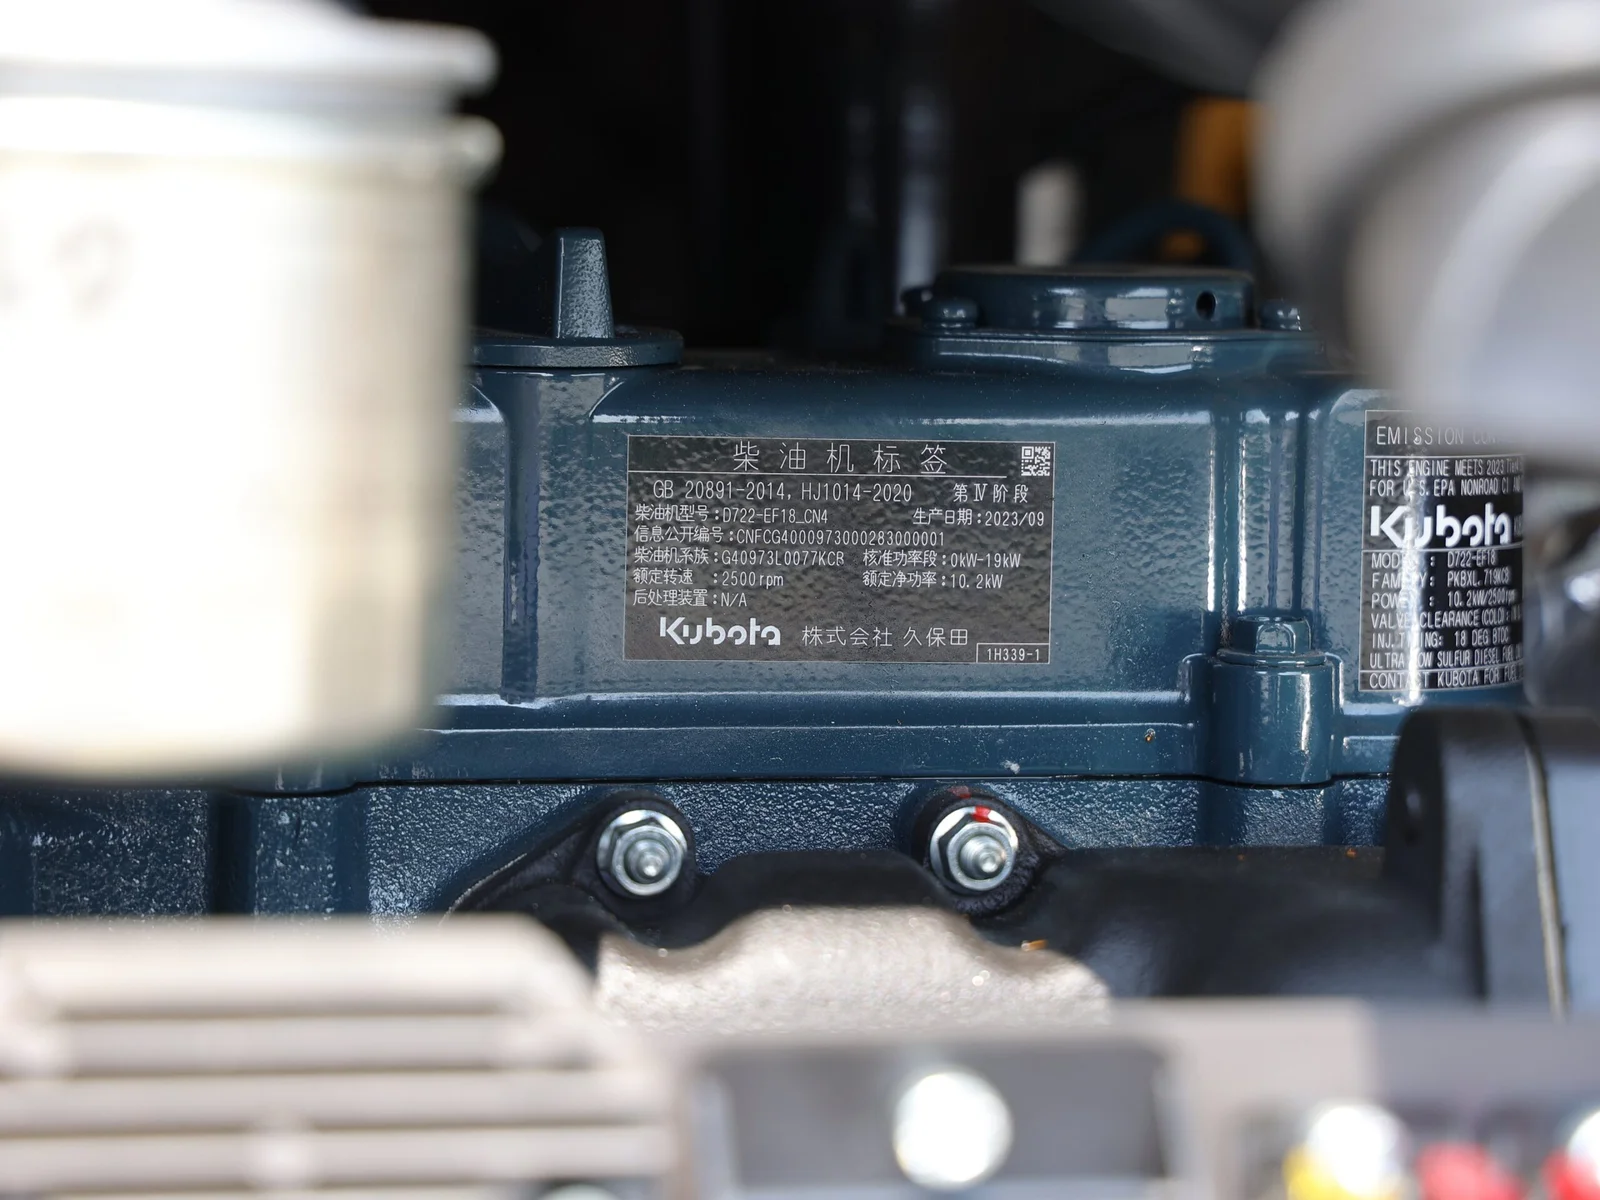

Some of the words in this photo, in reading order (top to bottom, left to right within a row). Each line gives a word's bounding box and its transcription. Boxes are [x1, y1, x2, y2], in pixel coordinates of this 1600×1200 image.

[1376, 425, 1464, 446] EMISSION
[733, 441, 949, 475] 柴油机标签
[1370, 459, 1401, 477] THIS
[1408, 459, 1450, 476] ENGINE
[1454, 458, 1484, 476] MEETS
[1486, 459, 1505, 475] 2023
[652, 479, 675, 499] GB
[800, 482, 914, 502] HJ1014-2020
[1369, 479, 1395, 497] FOR
[1433, 478, 1456, 497] EPA
[1460, 477, 1499, 496] NONROAD
[1370, 502, 1512, 549] Kubota
[1370, 552, 1418, 569] MOD
[1370, 611, 1411, 630] VALVE
[1419, 608, 1480, 629] CLEARANCE
[659, 616, 782, 647] Kubota
[801, 627, 893, 649] 株式会社
[903, 627, 969, 648] 久保田
[1454, 629, 1468, 647] 18
[1471, 627, 1491, 646] DEG
[986, 647, 1042, 662] 1H339-1
[1369, 652, 1405, 670] ULTRA
[1409, 651, 1434, 668] OW
[1437, 649, 1473, 668] SULFUR
[1474, 647, 1500, 666] DIESEL
[1369, 671, 1430, 690] CONTT
[1437, 669, 1479, 688] KUBOTA
